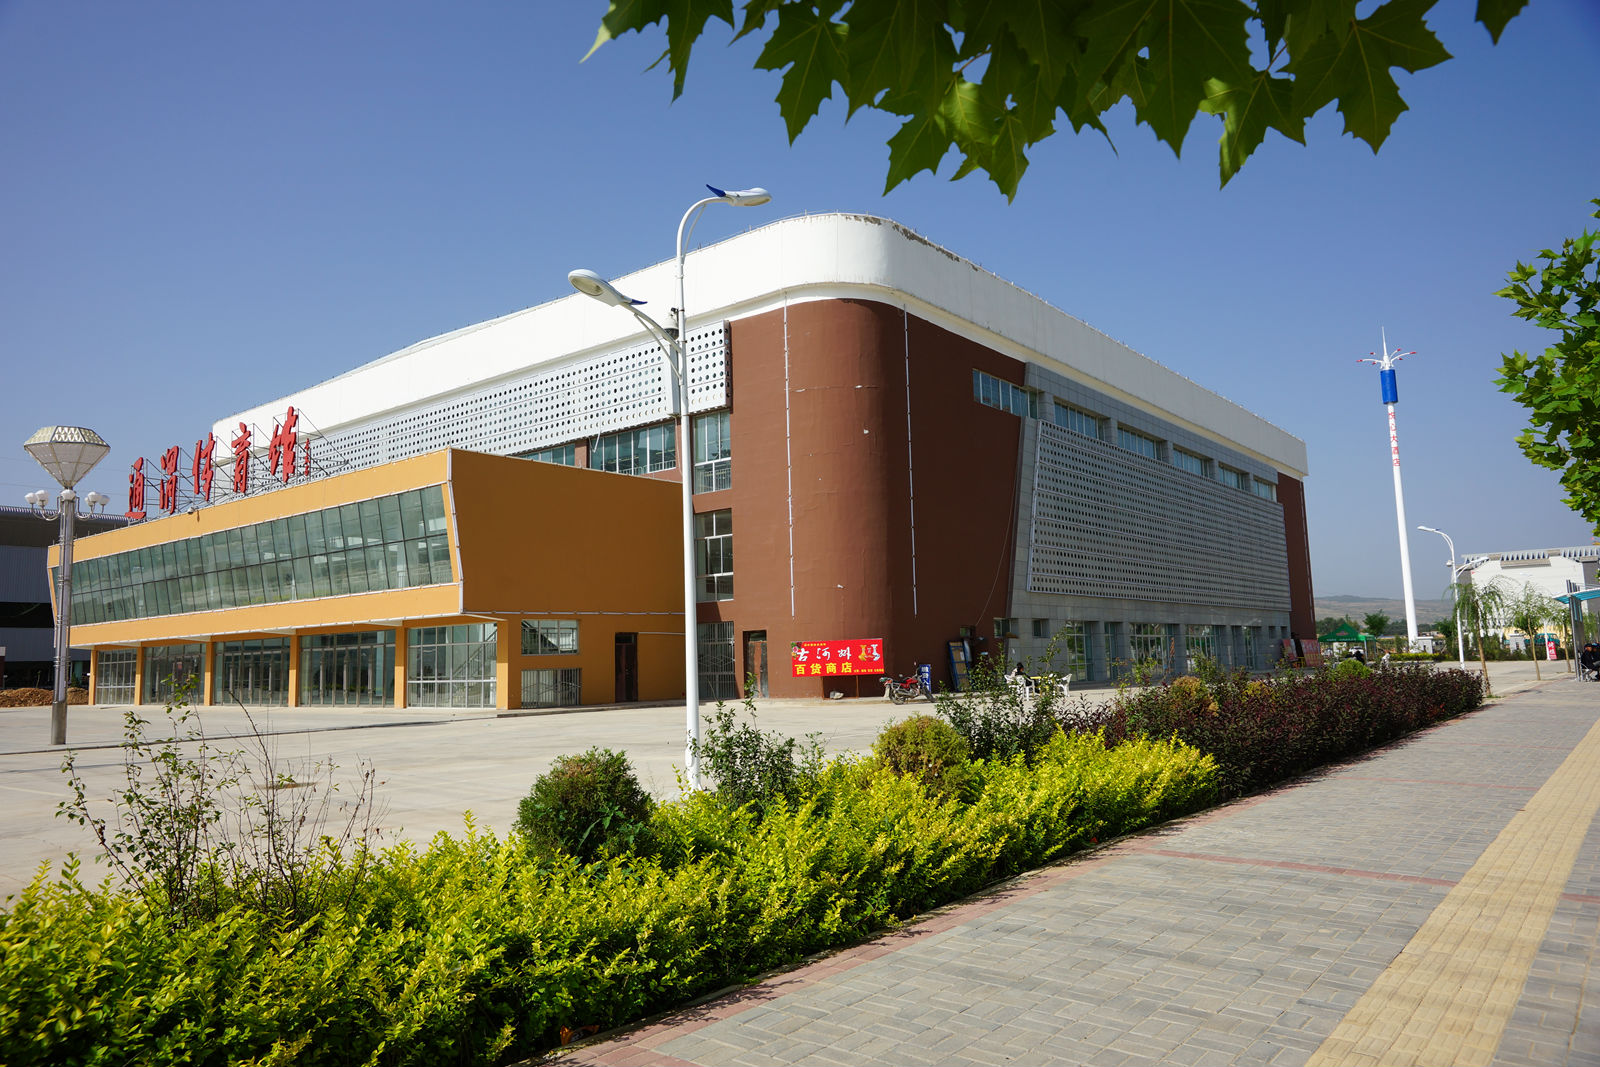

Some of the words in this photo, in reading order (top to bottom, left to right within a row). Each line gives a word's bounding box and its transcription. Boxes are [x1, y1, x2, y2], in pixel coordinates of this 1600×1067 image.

[125, 406, 298, 519] 通渭体育馆
[794, 662, 852, 675] 百货商店
